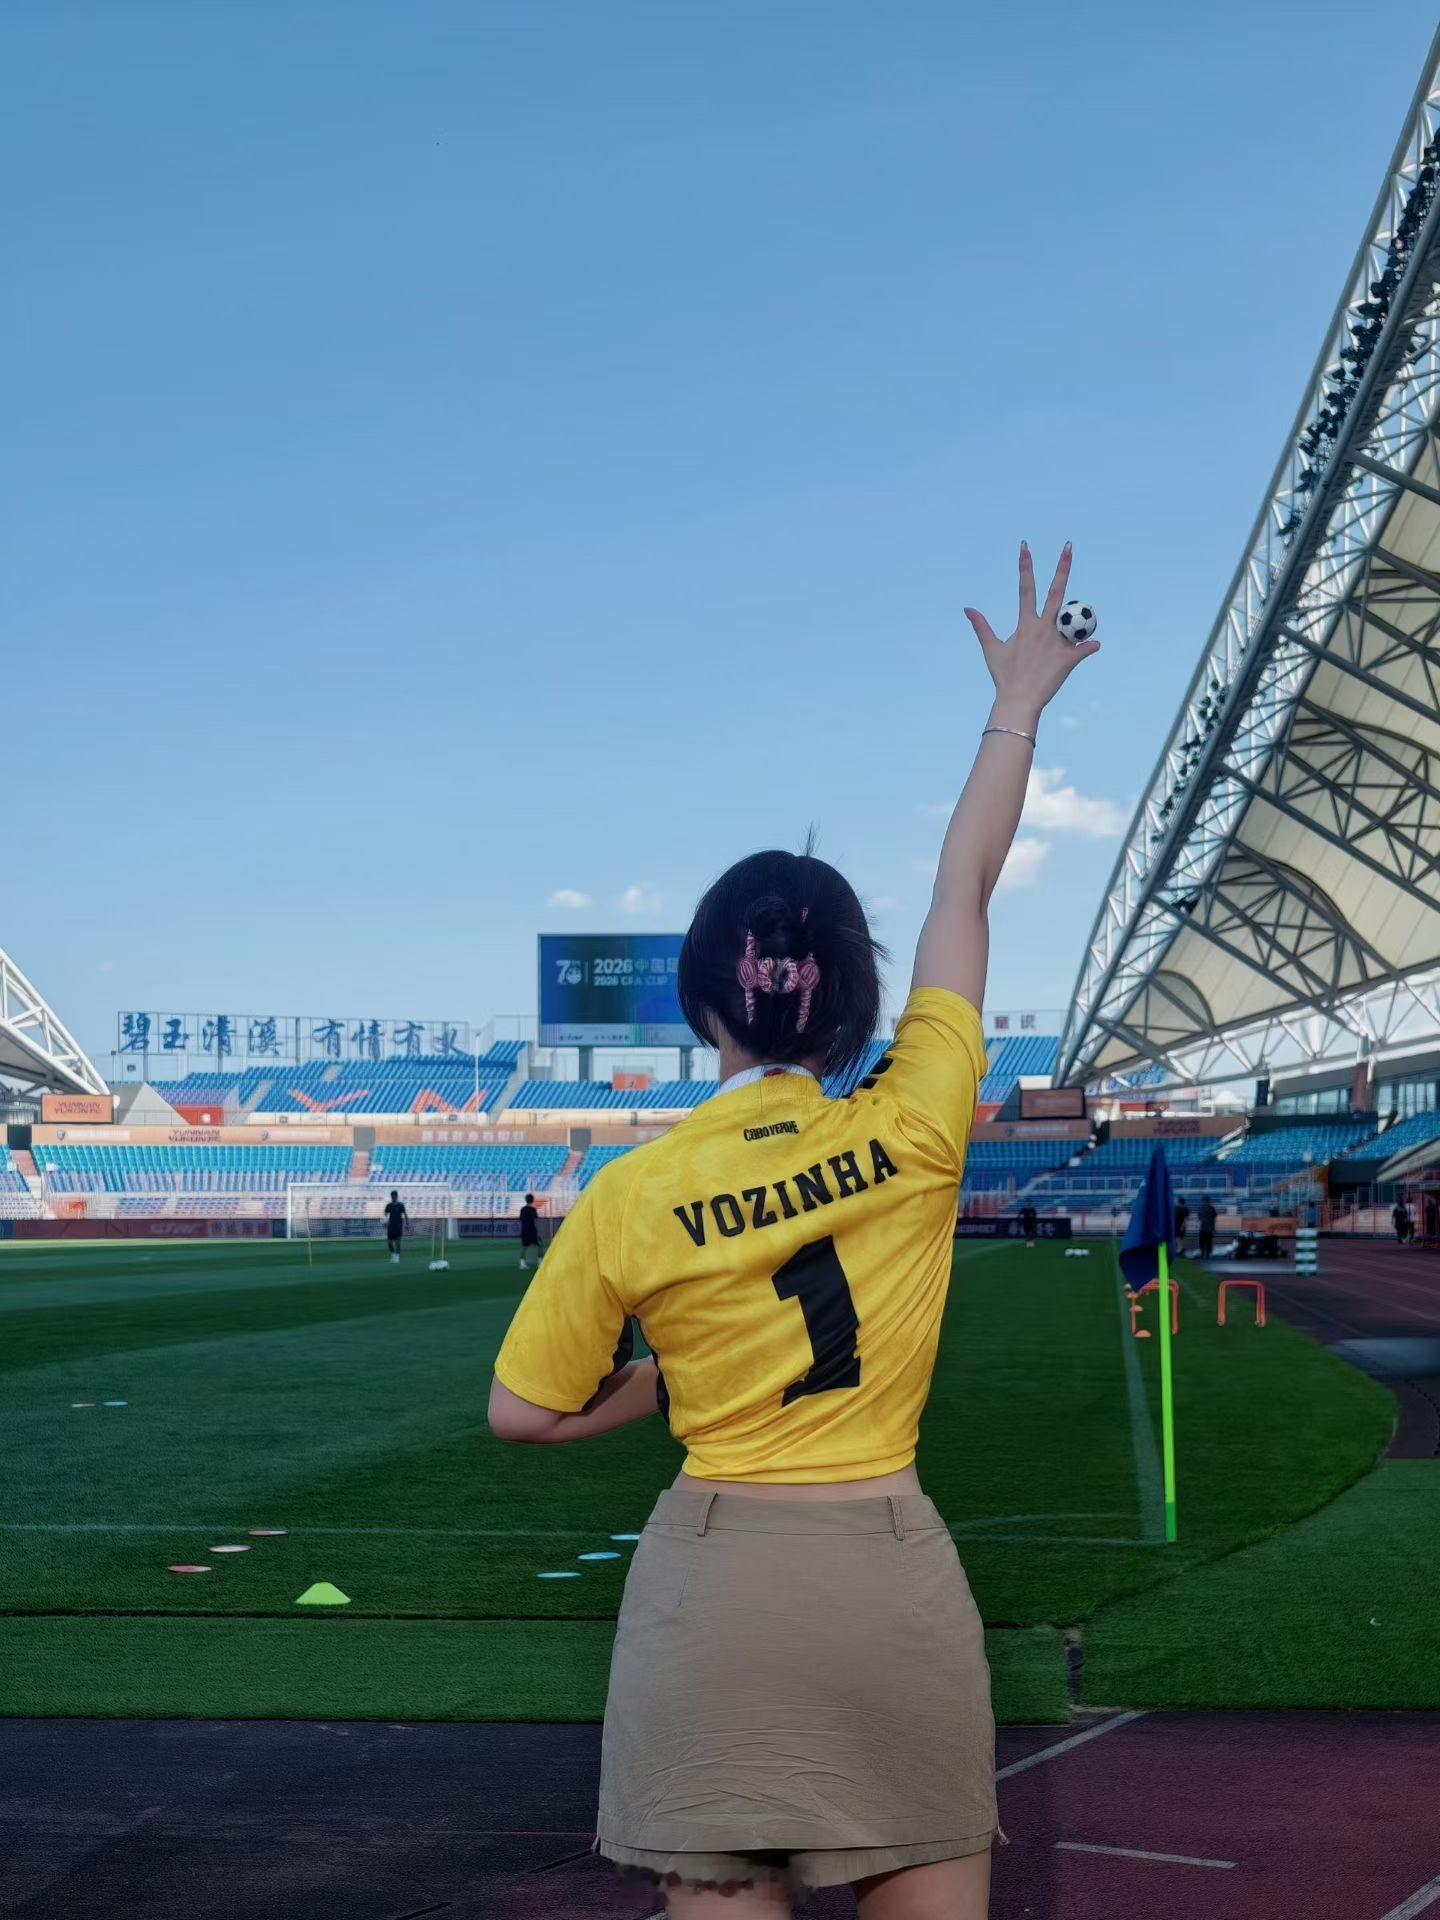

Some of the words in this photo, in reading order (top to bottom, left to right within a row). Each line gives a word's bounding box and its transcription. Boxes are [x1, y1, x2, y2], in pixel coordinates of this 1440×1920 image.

[593, 975, 620, 987] 2026
[673, 1138, 898, 1247] VOZINHA
[771, 1234, 861, 1408] 1
